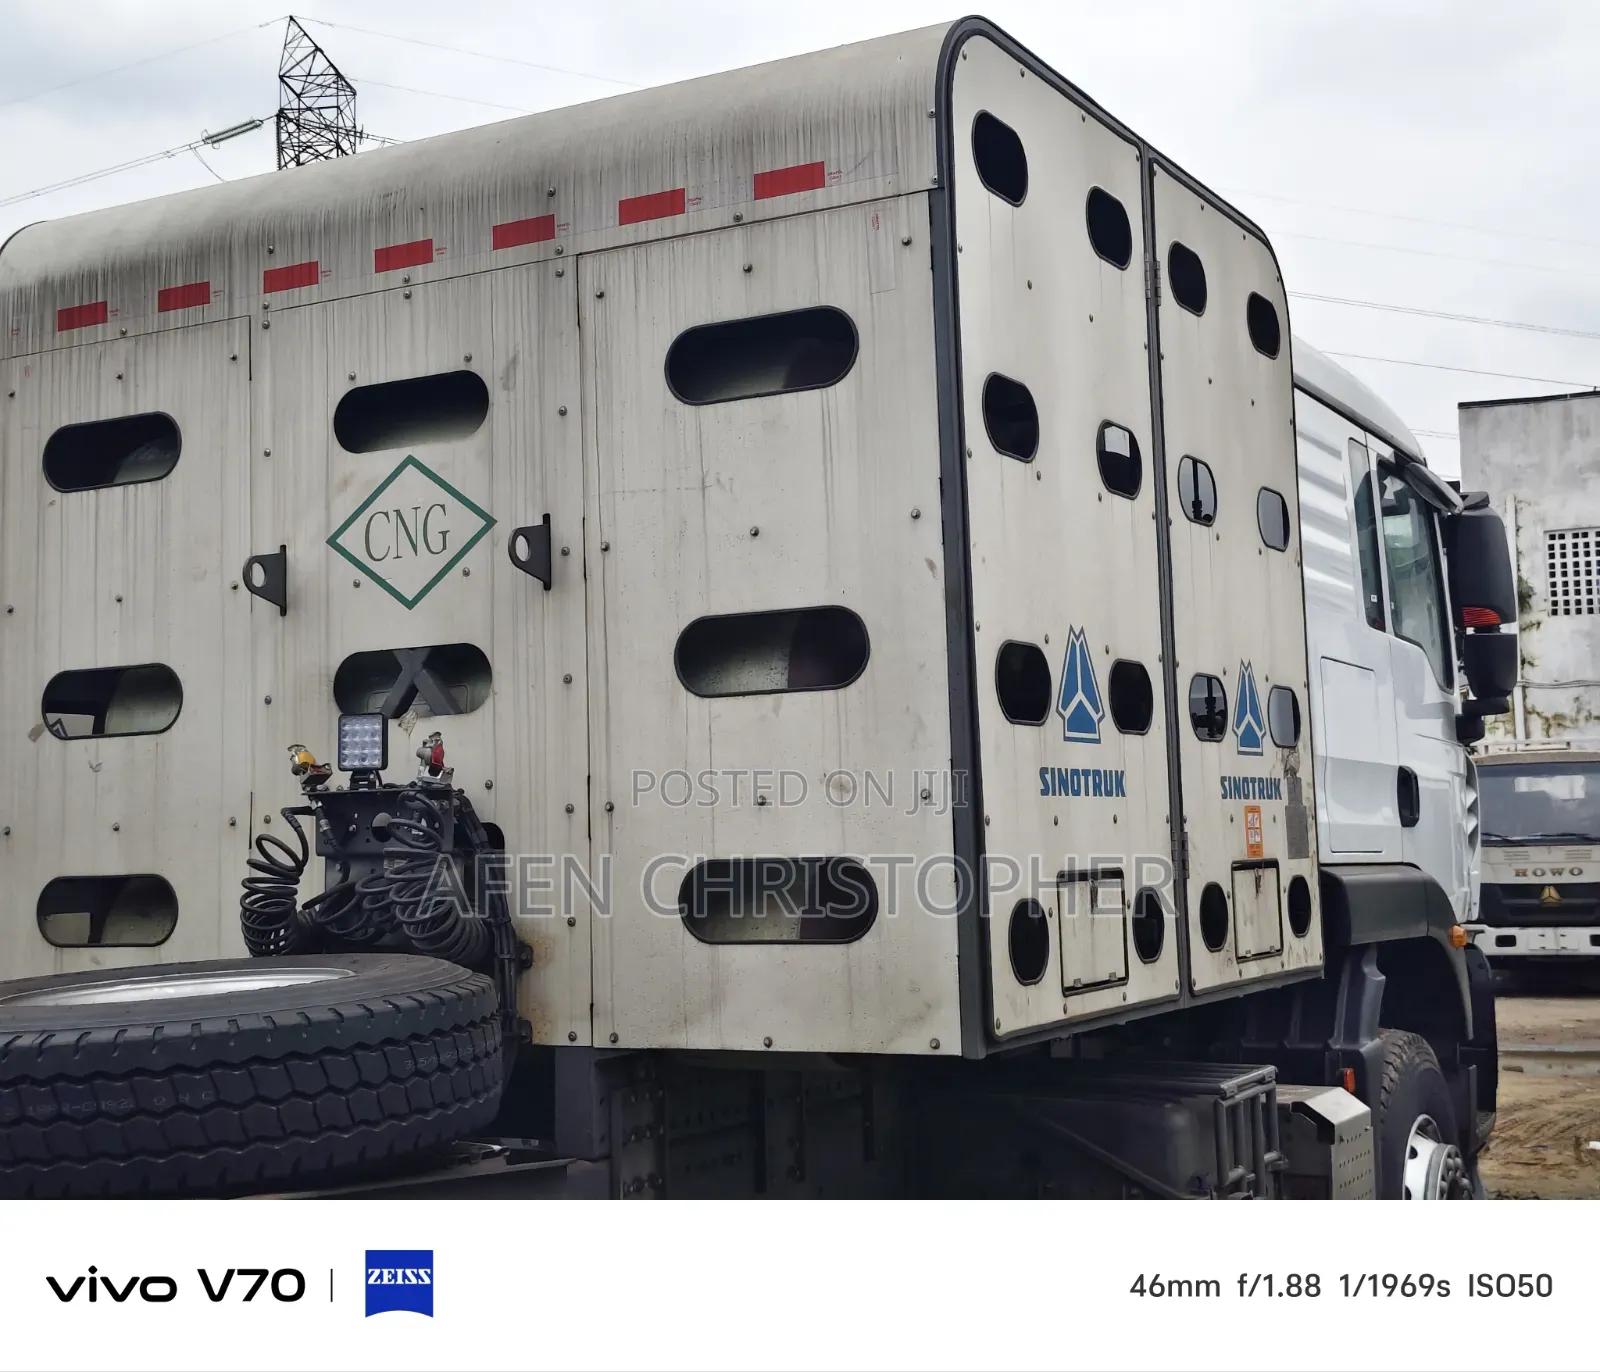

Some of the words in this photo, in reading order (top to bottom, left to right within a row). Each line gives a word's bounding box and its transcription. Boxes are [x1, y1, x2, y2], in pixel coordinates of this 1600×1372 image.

[364, 502, 451, 563] CNG
[1039, 766, 1126, 798] SINOTRUK
[1220, 775, 1282, 800] SINOTRUK
[1513, 866, 1584, 878] HOWO
